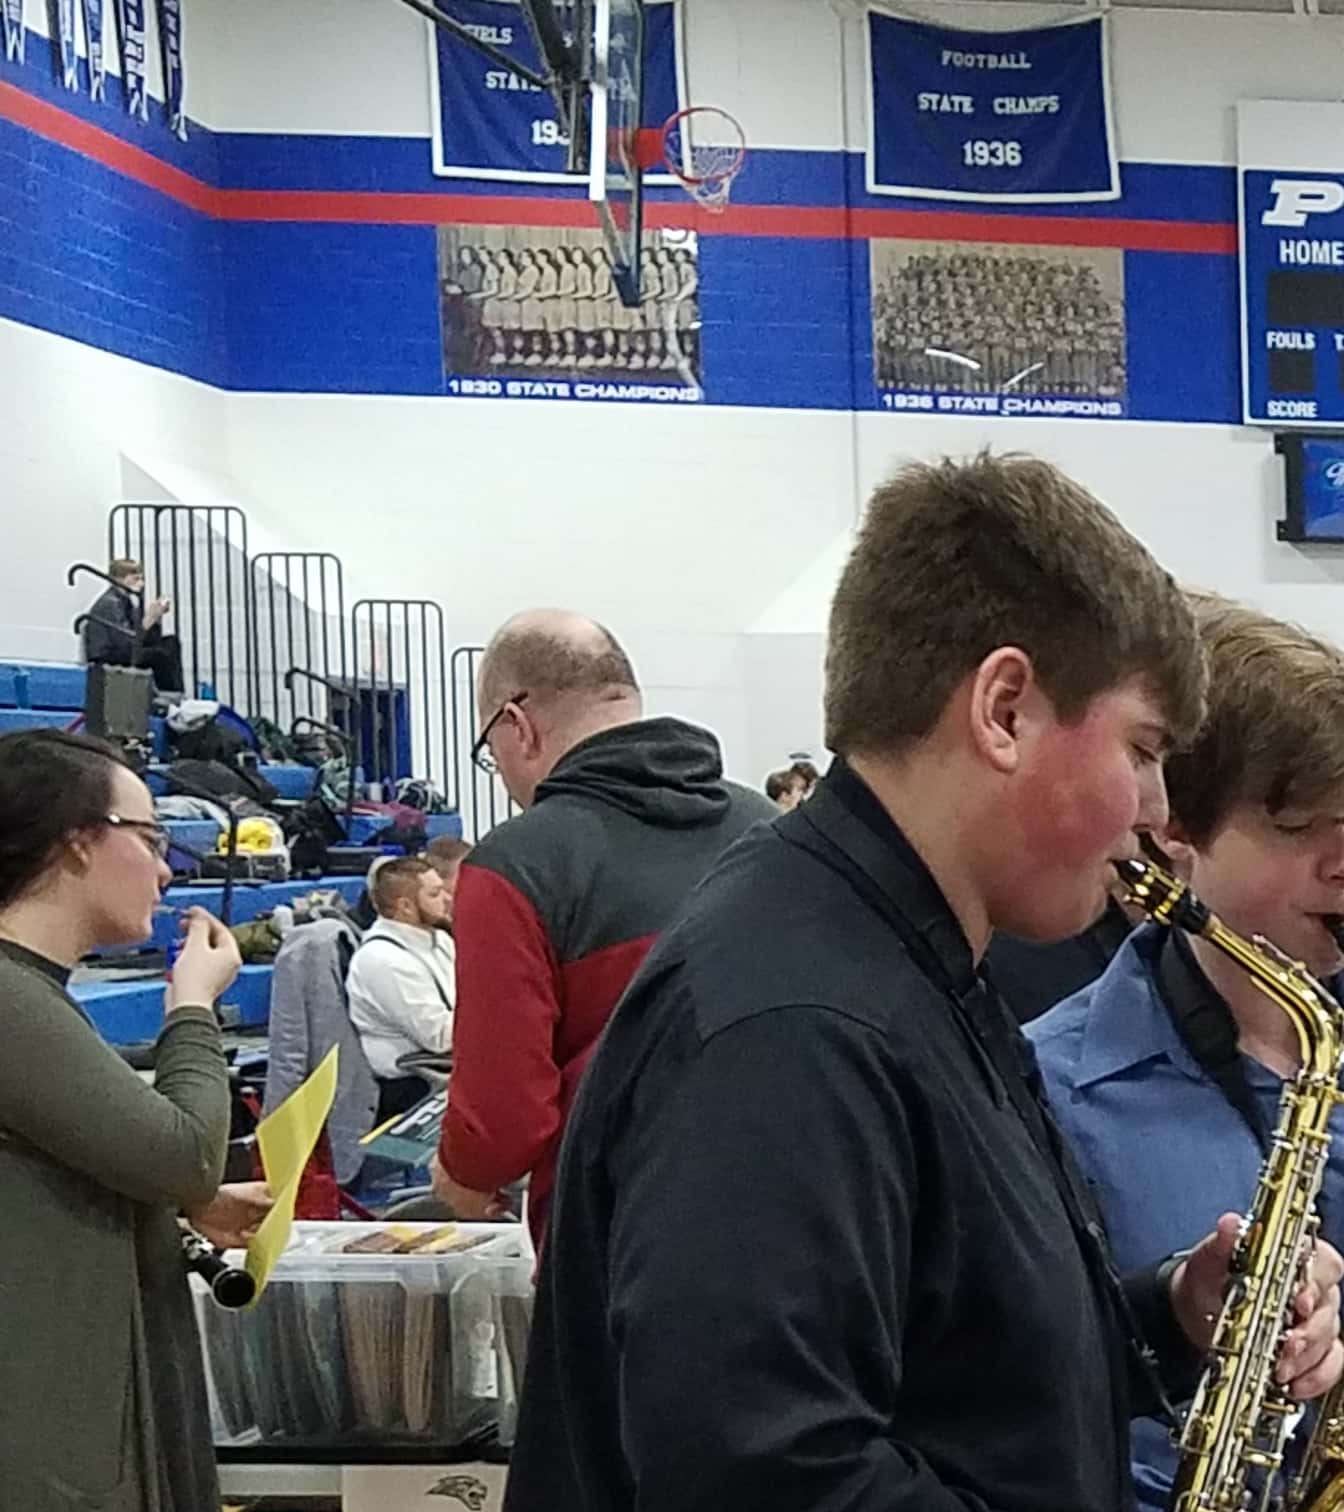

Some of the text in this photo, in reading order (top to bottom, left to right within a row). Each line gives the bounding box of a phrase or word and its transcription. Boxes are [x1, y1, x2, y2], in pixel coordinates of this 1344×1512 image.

[942, 50, 1032, 69] FOOTBALL
[917, 92, 1060, 115] STATE CHAMPS
[963, 140, 1022, 166] 1936
[1266, 331, 1316, 350] FOULS
[506, 381, 570, 397] STATE
[574, 383, 700, 401] CHAMPIONS
[883, 393, 1122, 415] 1936 STATE CHAMPIONS
[1267, 400, 1318, 419] SCORE
